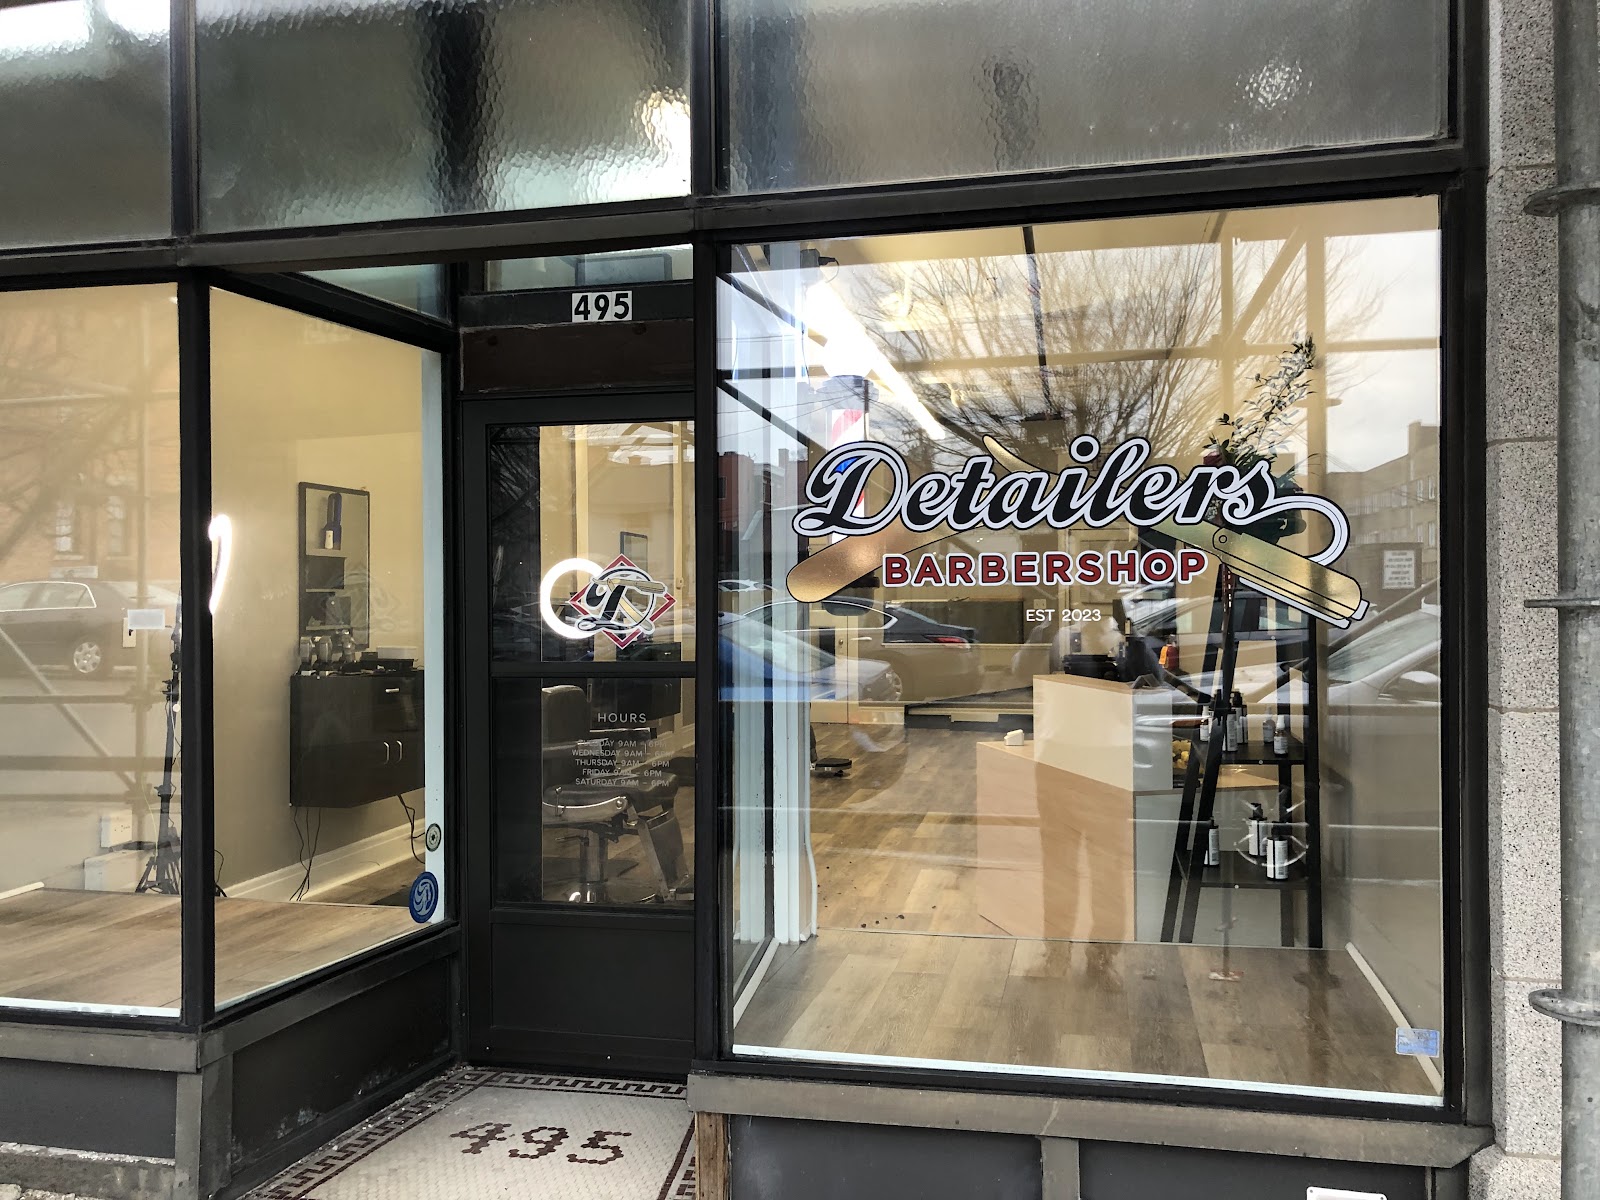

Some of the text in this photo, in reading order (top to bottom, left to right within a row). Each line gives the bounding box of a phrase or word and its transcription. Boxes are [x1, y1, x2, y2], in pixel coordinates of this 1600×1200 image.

[574, 293, 629, 320] 495
[792, 434, 1349, 564] Detailers
[882, 549, 1208, 587] BARBERSHOP
[1026, 609, 1101, 622] EST 2023
[597, 713, 647, 723] HOURS
[572, 749, 620, 757] WEDNESDAY
[651, 760, 670, 768] 6PM
[575, 778, 617, 786] SATURDAY
[620, 778, 639, 786] 9AM
[650, 779, 670, 787] 6PM
[450, 1122, 632, 1165] 495
